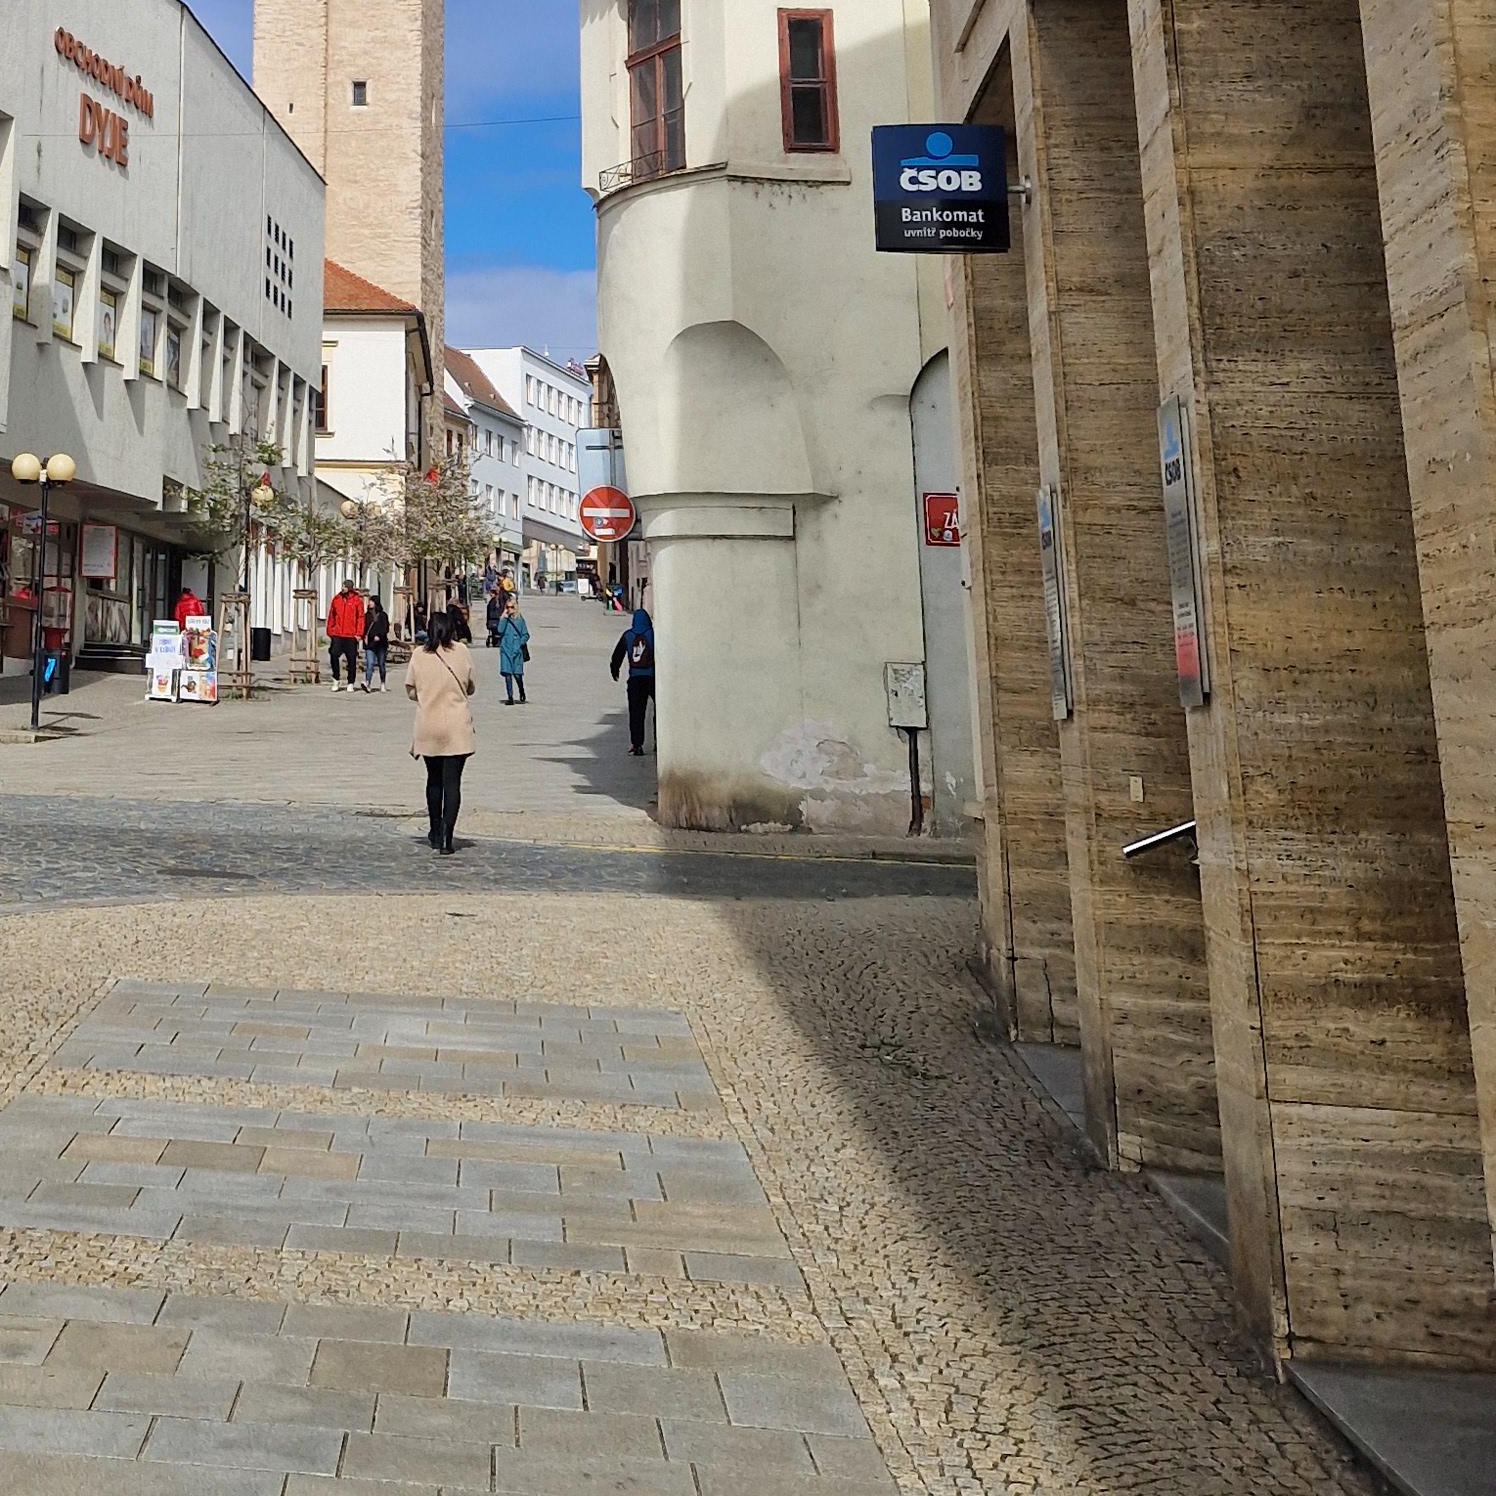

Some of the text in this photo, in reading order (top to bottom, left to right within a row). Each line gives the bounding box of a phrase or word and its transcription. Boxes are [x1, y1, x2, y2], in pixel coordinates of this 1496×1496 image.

[79, 93, 129, 167] DYJE
[900, 167, 983, 192] ČSOB
[901, 207, 985, 223] Bankomat
[904, 227, 984, 240] uvnitř pobočky
[944, 508, 960, 529] ZÁ
